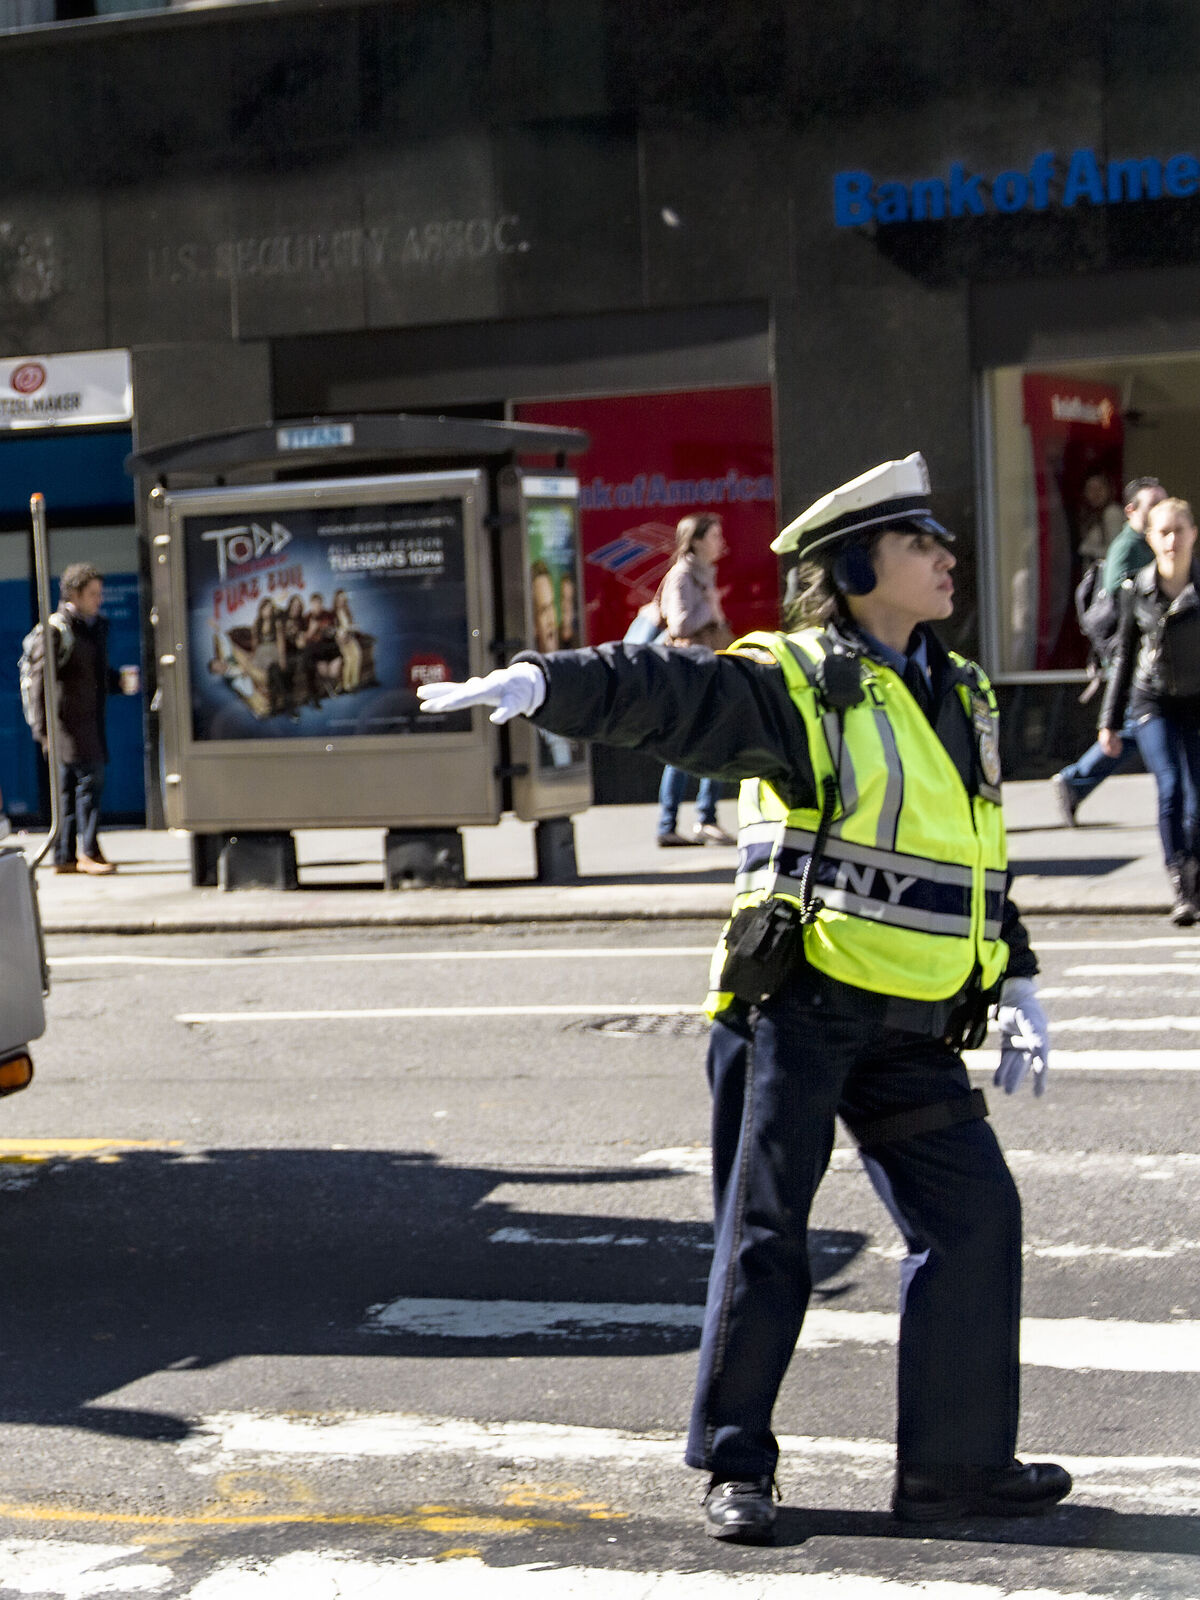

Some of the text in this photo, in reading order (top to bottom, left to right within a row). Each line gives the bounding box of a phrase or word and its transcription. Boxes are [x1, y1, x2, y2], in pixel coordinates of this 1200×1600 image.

[833, 161, 986, 228] Bank
[992, 151, 1055, 213] of
[579, 477, 612, 509] nk
[615, 474, 647, 507] of
[648, 469, 774, 506] America
[201, 522, 292, 582] TODD
[329, 551, 407, 571] TUESDAYS
[835, 861, 917, 905] NY
